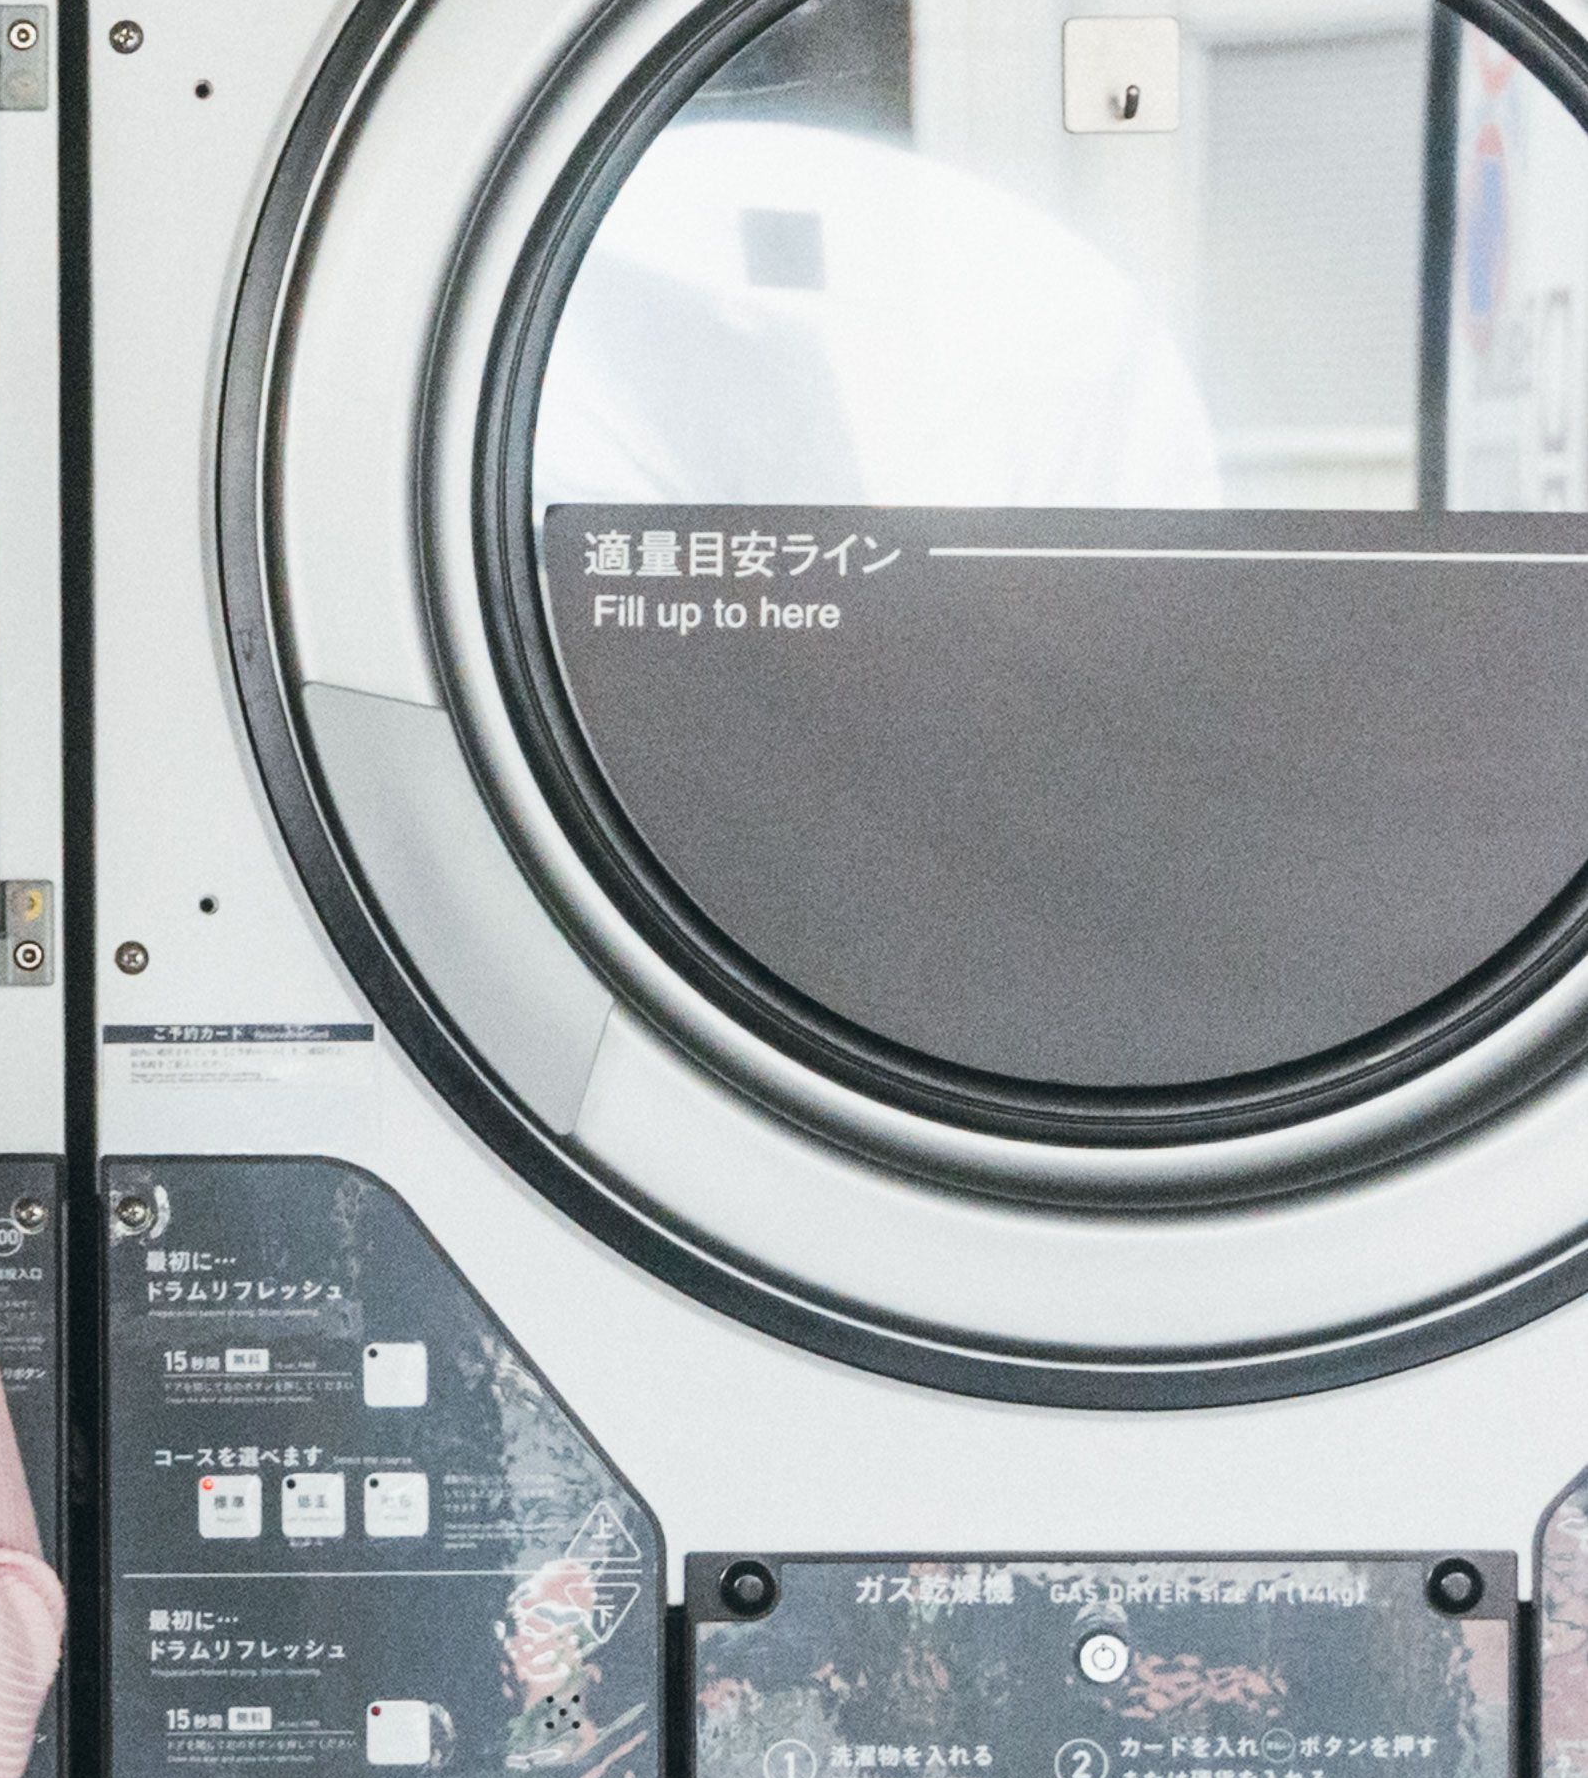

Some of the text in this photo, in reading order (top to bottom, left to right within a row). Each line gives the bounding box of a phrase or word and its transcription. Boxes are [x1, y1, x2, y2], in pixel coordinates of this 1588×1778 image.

[585, 530, 900, 577] 適量目安ライン
[595, 595, 840, 635] Fill up to here
[149, 1281, 342, 1303] ドラムリフレッシュ
[156, 1446, 322, 1467] コースを選べます
[856, 1575, 1015, 1605] ガス乾燥機
[1050, 1585, 1099, 1604] GAS
[1109, 1583, 1190, 1604] DRYER
[1257, 1583, 1277, 1602] M
[151, 1640, 345, 1660] ドラムリフレッシュ
[830, 1744, 994, 1768] 洗濯物を入れる
